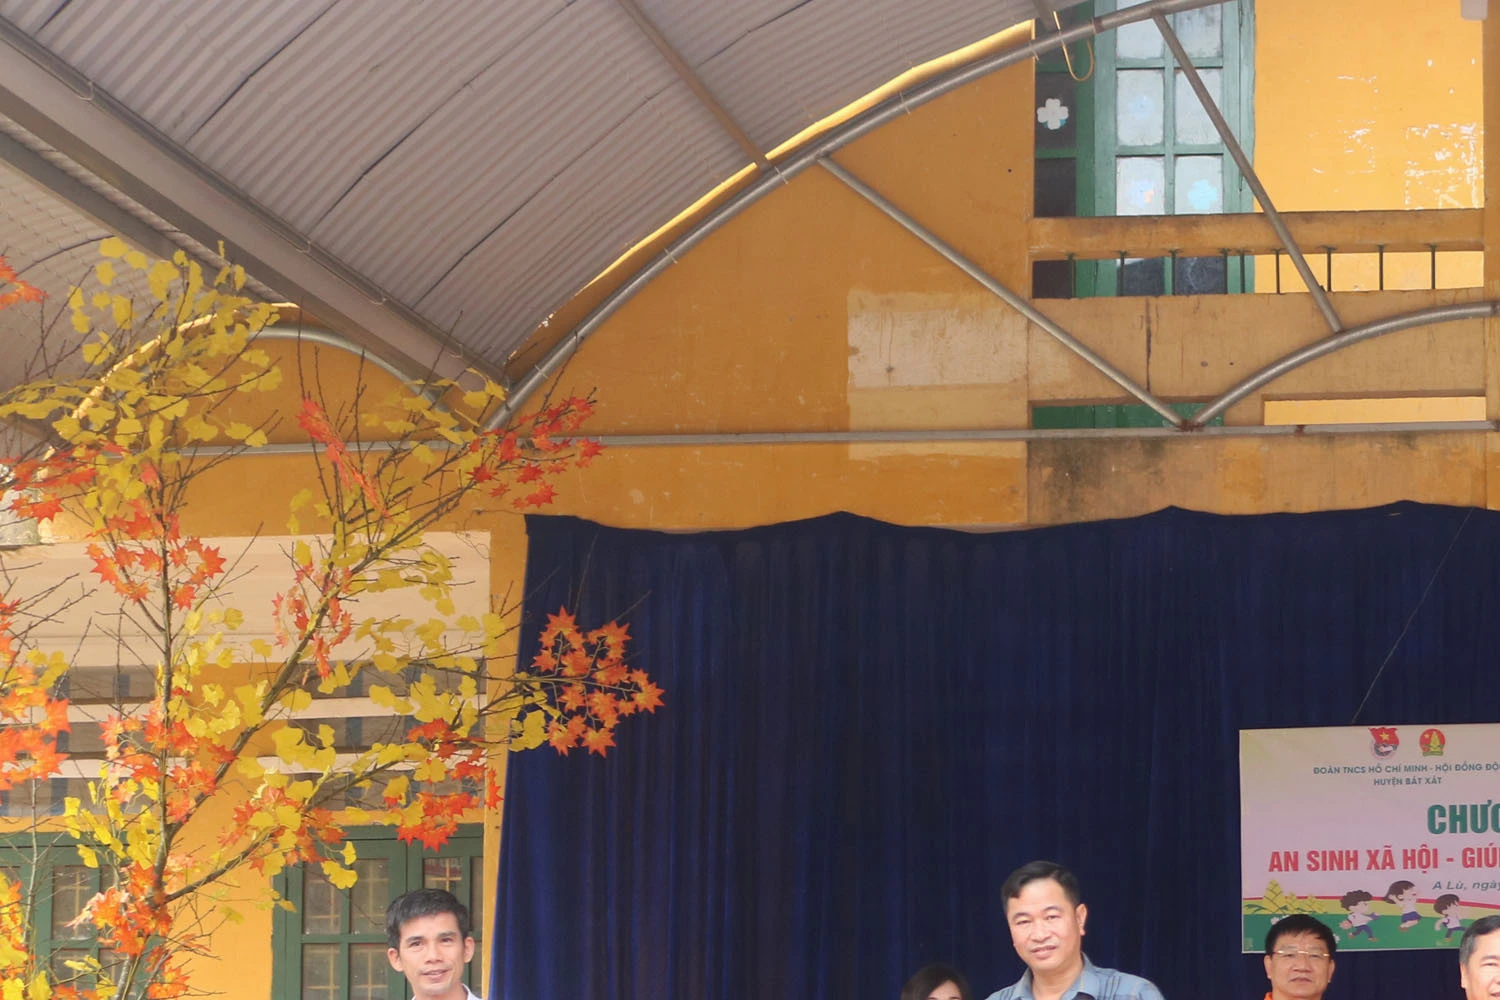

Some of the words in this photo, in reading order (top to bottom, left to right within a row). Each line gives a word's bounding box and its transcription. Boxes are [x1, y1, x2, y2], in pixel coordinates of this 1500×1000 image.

[1313, 764, 1340, 774] ĐOÀN
[1343, 766, 1366, 774] TNCS
[1368, 763, 1382, 773] HỒ
[1385, 764, 1401, 773] CHÍ
[1404, 764, 1428, 773] MINH
[1435, 762, 1452, 773] HỘI
[1454, 762, 1482, 772] ĐỒNG
[1373, 776, 1402, 786] HUYỆN
[1268, 850, 1299, 872] AN
[1306, 850, 1358, 871] SINH
[1366, 844, 1395, 870] XÃ
[1402, 844, 1438, 874] HỘI
[1432, 881, 1442, 890] A
